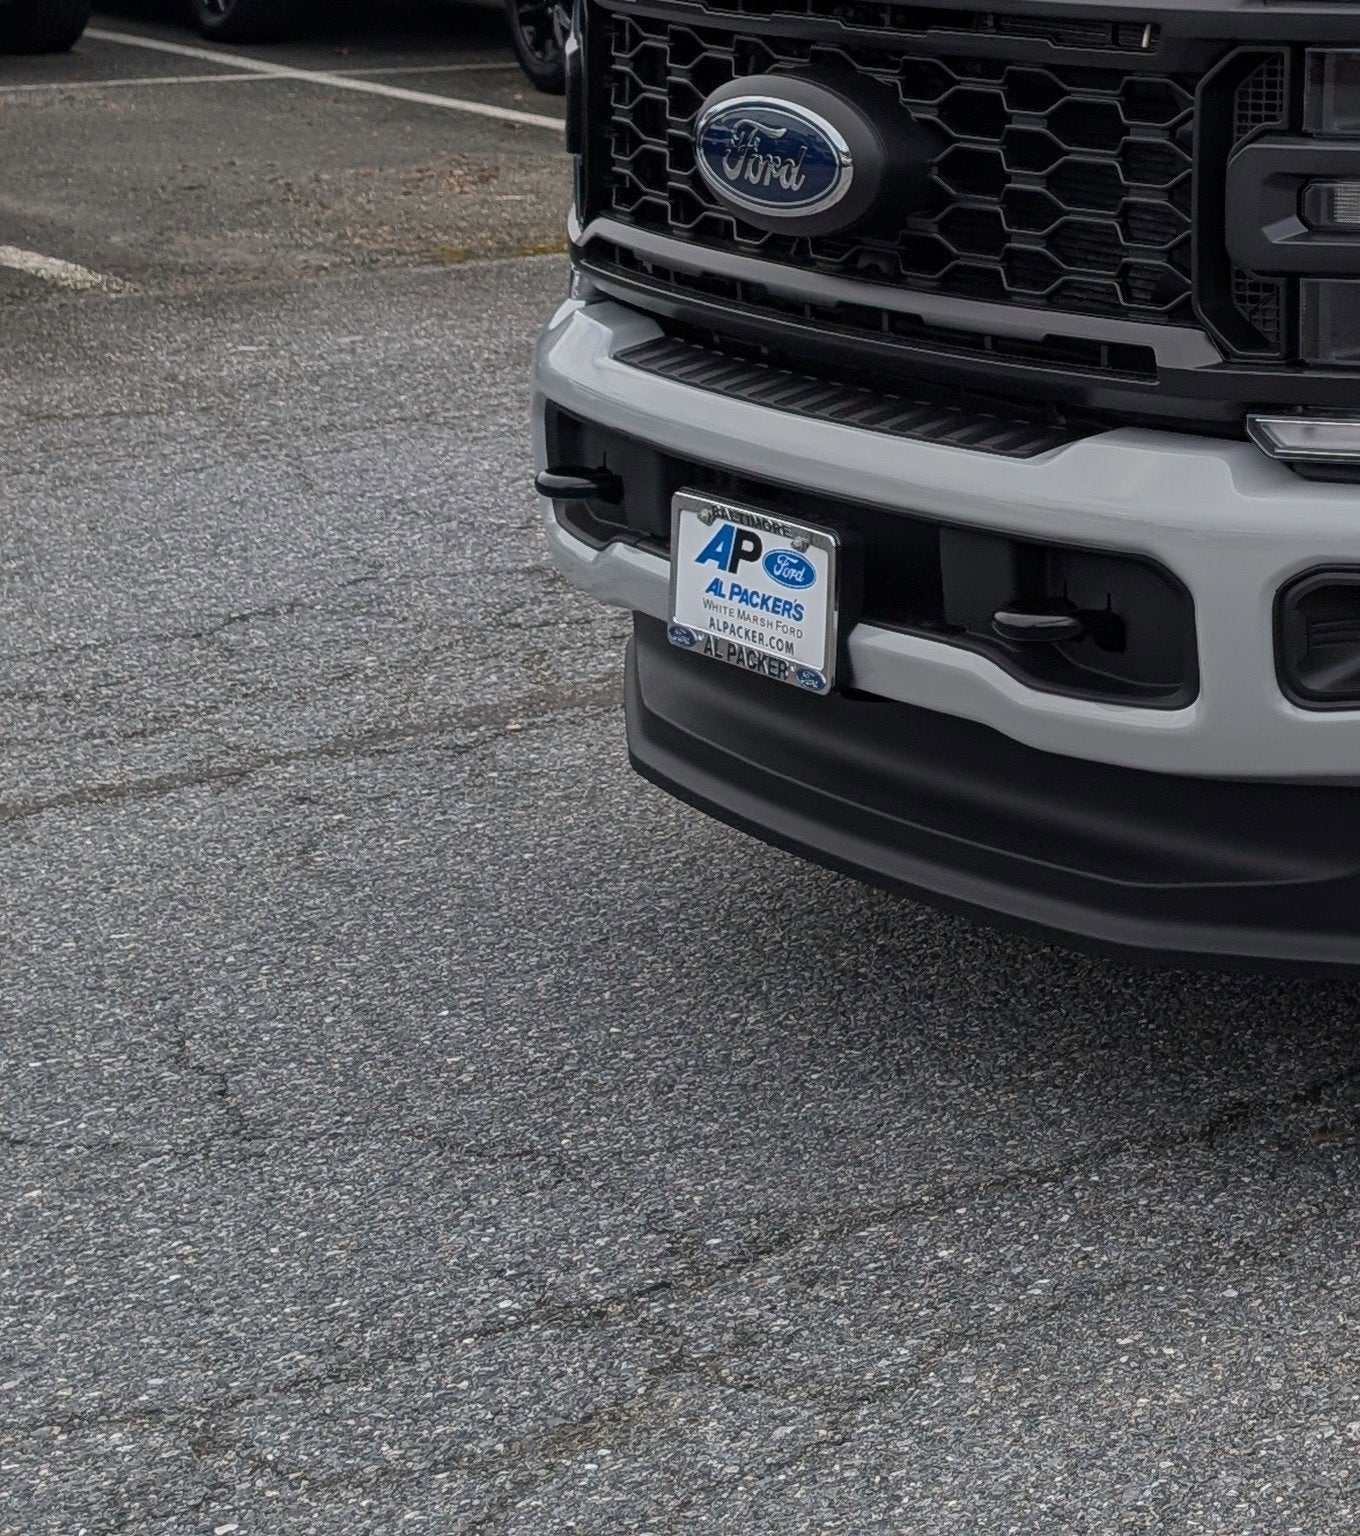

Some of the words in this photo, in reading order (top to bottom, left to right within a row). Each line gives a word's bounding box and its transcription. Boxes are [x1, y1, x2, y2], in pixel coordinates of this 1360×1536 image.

[722, 118, 806, 192] Ford
[694, 523, 763, 575] AP
[702, 597, 735, 617] WHITE
[737, 608, 774, 630] MARSH
[775, 619, 804, 640] FORD
[704, 577, 727, 599] AL
[728, 582, 805, 622] PACKER'S
[703, 635, 723, 659] AL
[726, 641, 790, 681] PACKER
[708, 616, 795, 655] ALPACKER.COM
